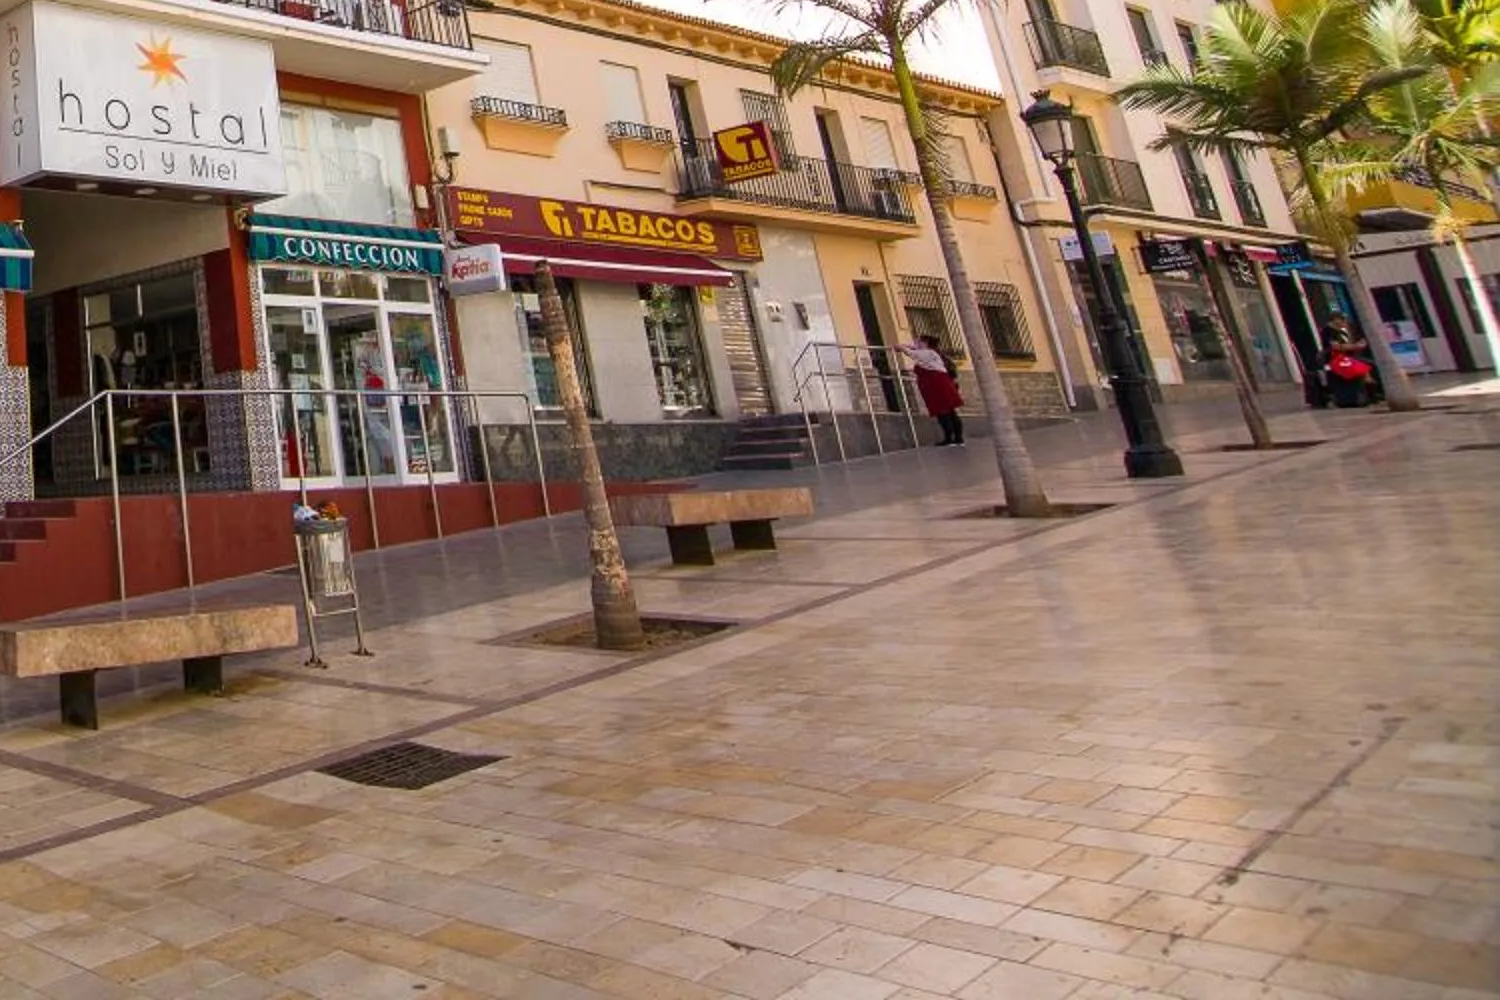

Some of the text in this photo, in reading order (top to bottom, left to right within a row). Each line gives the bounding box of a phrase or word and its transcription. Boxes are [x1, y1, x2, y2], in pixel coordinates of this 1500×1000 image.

[58, 77, 268, 149] hostal
[104, 144, 145, 173] Sol
[190, 152, 238, 181] Miel
[723, 159, 773, 177] TABACOS
[576, 206, 716, 245] TABACOS
[283, 236, 420, 268] CONFECCION
